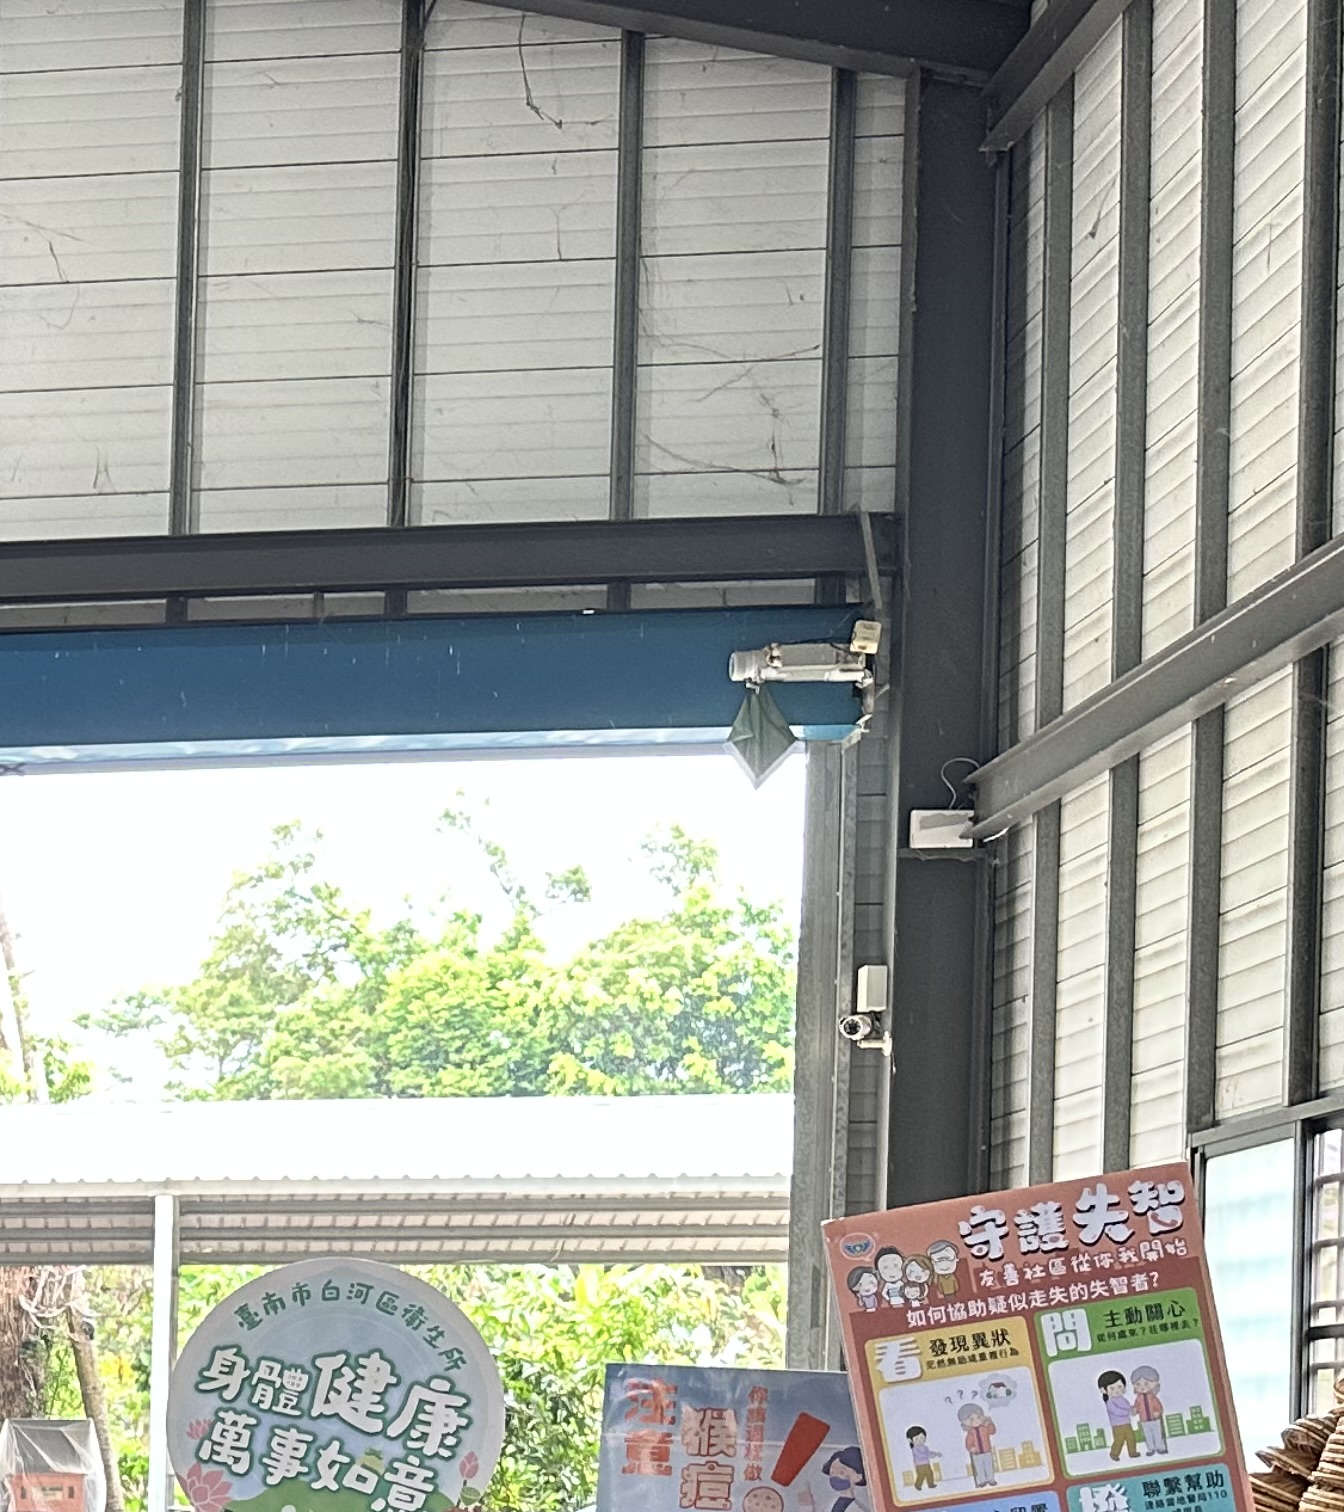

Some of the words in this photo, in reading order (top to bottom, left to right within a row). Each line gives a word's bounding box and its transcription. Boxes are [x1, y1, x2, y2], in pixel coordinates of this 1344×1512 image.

[958, 1179, 1186, 1261] 守護失智
[979, 1236, 1188, 1288] 友善社區從你我開始
[233, 1278, 469, 1373] 臺南市白河區衛生所
[905, 1270, 1160, 1329] 如何協助疑似走失的失智者？
[1102, 1299, 1186, 1329] 主動關心
[929, 1327, 1012, 1358] 發現異狀
[1040, 1307, 1093, 1358] 問
[874, 1336, 922, 1384] 看
[196, 1346, 469, 1459] 身體健康
[678, 1404, 738, 1511] 猴痘
[1140, 1469, 1225, 1498] 聯繫幫助
